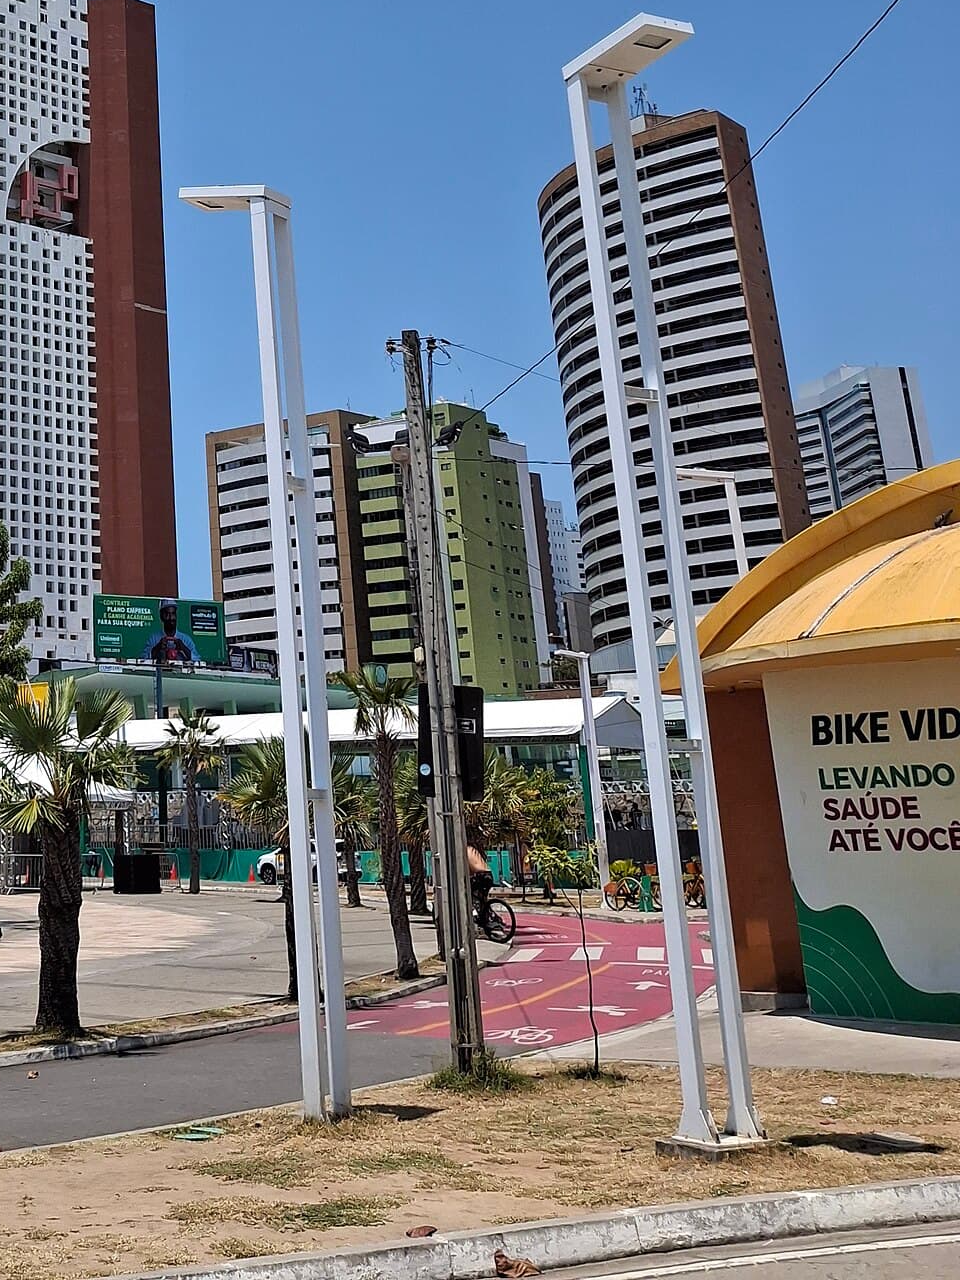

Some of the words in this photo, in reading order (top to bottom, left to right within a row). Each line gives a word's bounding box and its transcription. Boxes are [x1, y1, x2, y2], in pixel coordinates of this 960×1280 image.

[811, 711, 890, 746] BIKE
[818, 763, 956, 791] LEVANDO
[823, 791, 921, 821] SAÚDE
[828, 823, 882, 852] ATÉ
[886, 820, 960, 852] VOCÊ
